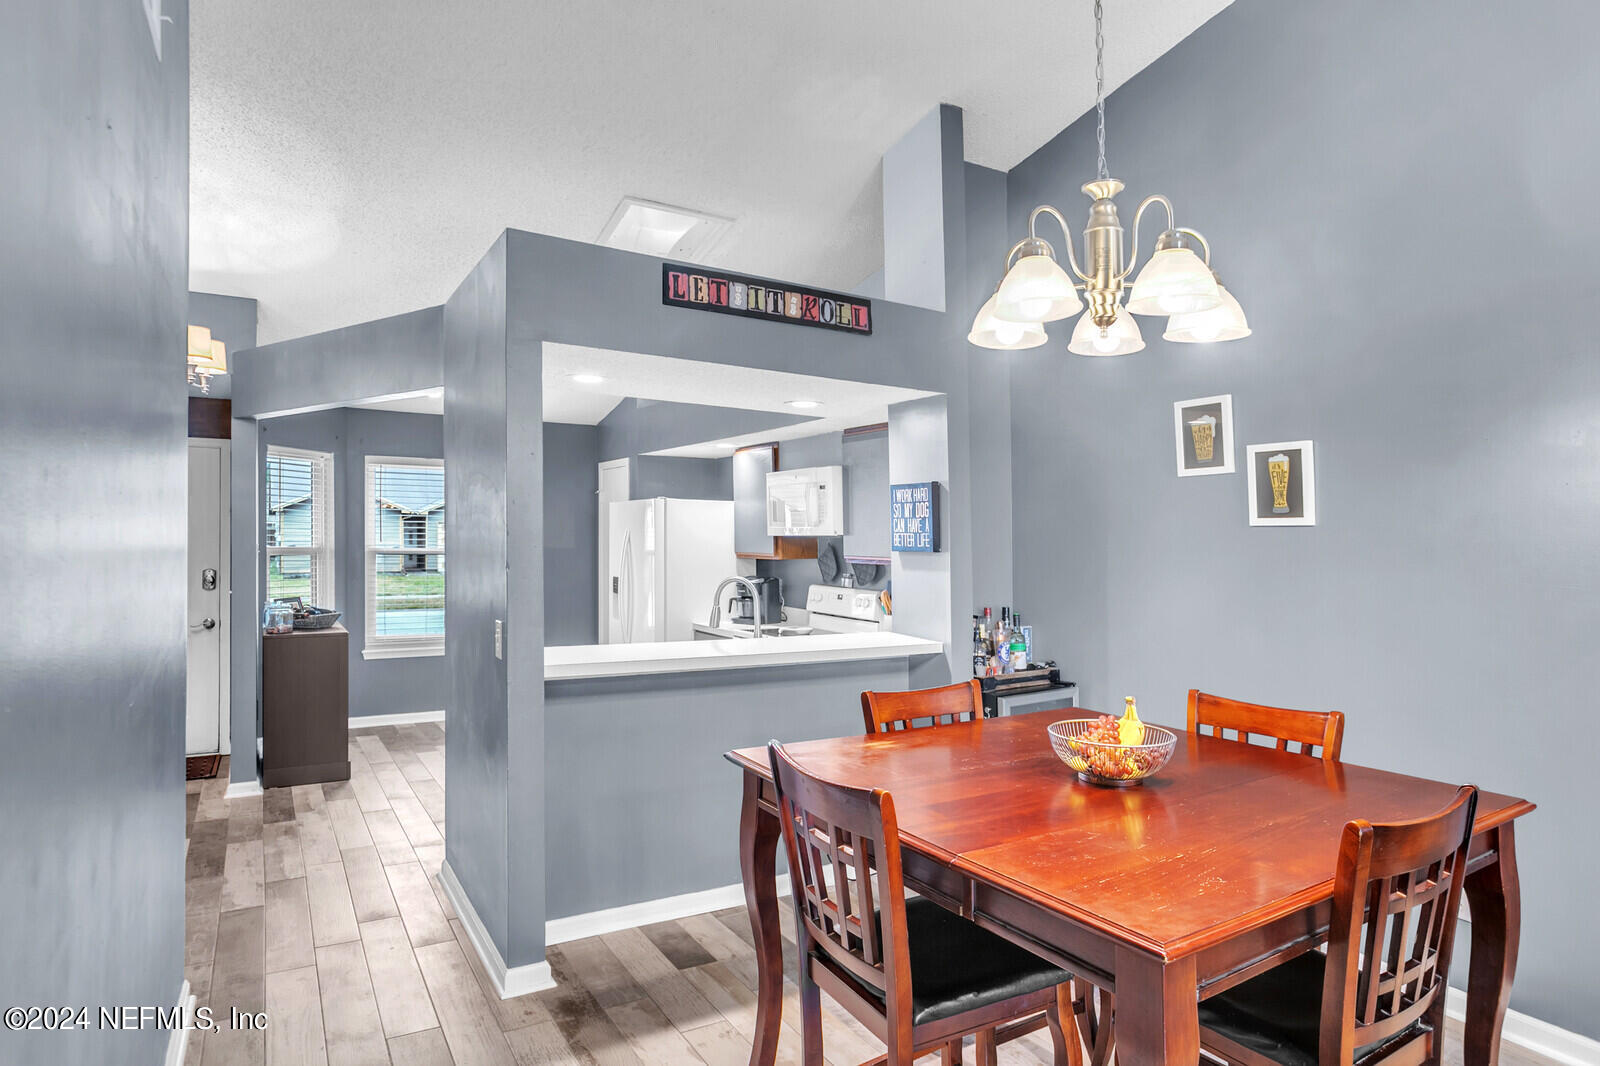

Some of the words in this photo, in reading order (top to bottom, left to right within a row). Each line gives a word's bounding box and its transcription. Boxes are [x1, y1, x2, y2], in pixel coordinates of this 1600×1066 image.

[671, 273, 727, 305] LET
[750, 286, 783, 314] IT
[803, 295, 867, 328] ROLL
[896, 488, 913, 503] WORK
[913, 487, 929, 502] HARD
[893, 503, 902, 518] SO
[904, 503, 913, 518] MY
[916, 502, 929, 518] DOG
[893, 518, 905, 532] CAN
[907, 518, 923, 533] HAVE
[925, 518, 929, 532] A
[894, 533, 915, 547] BETTER
[917, 532, 930, 548] LIFE
